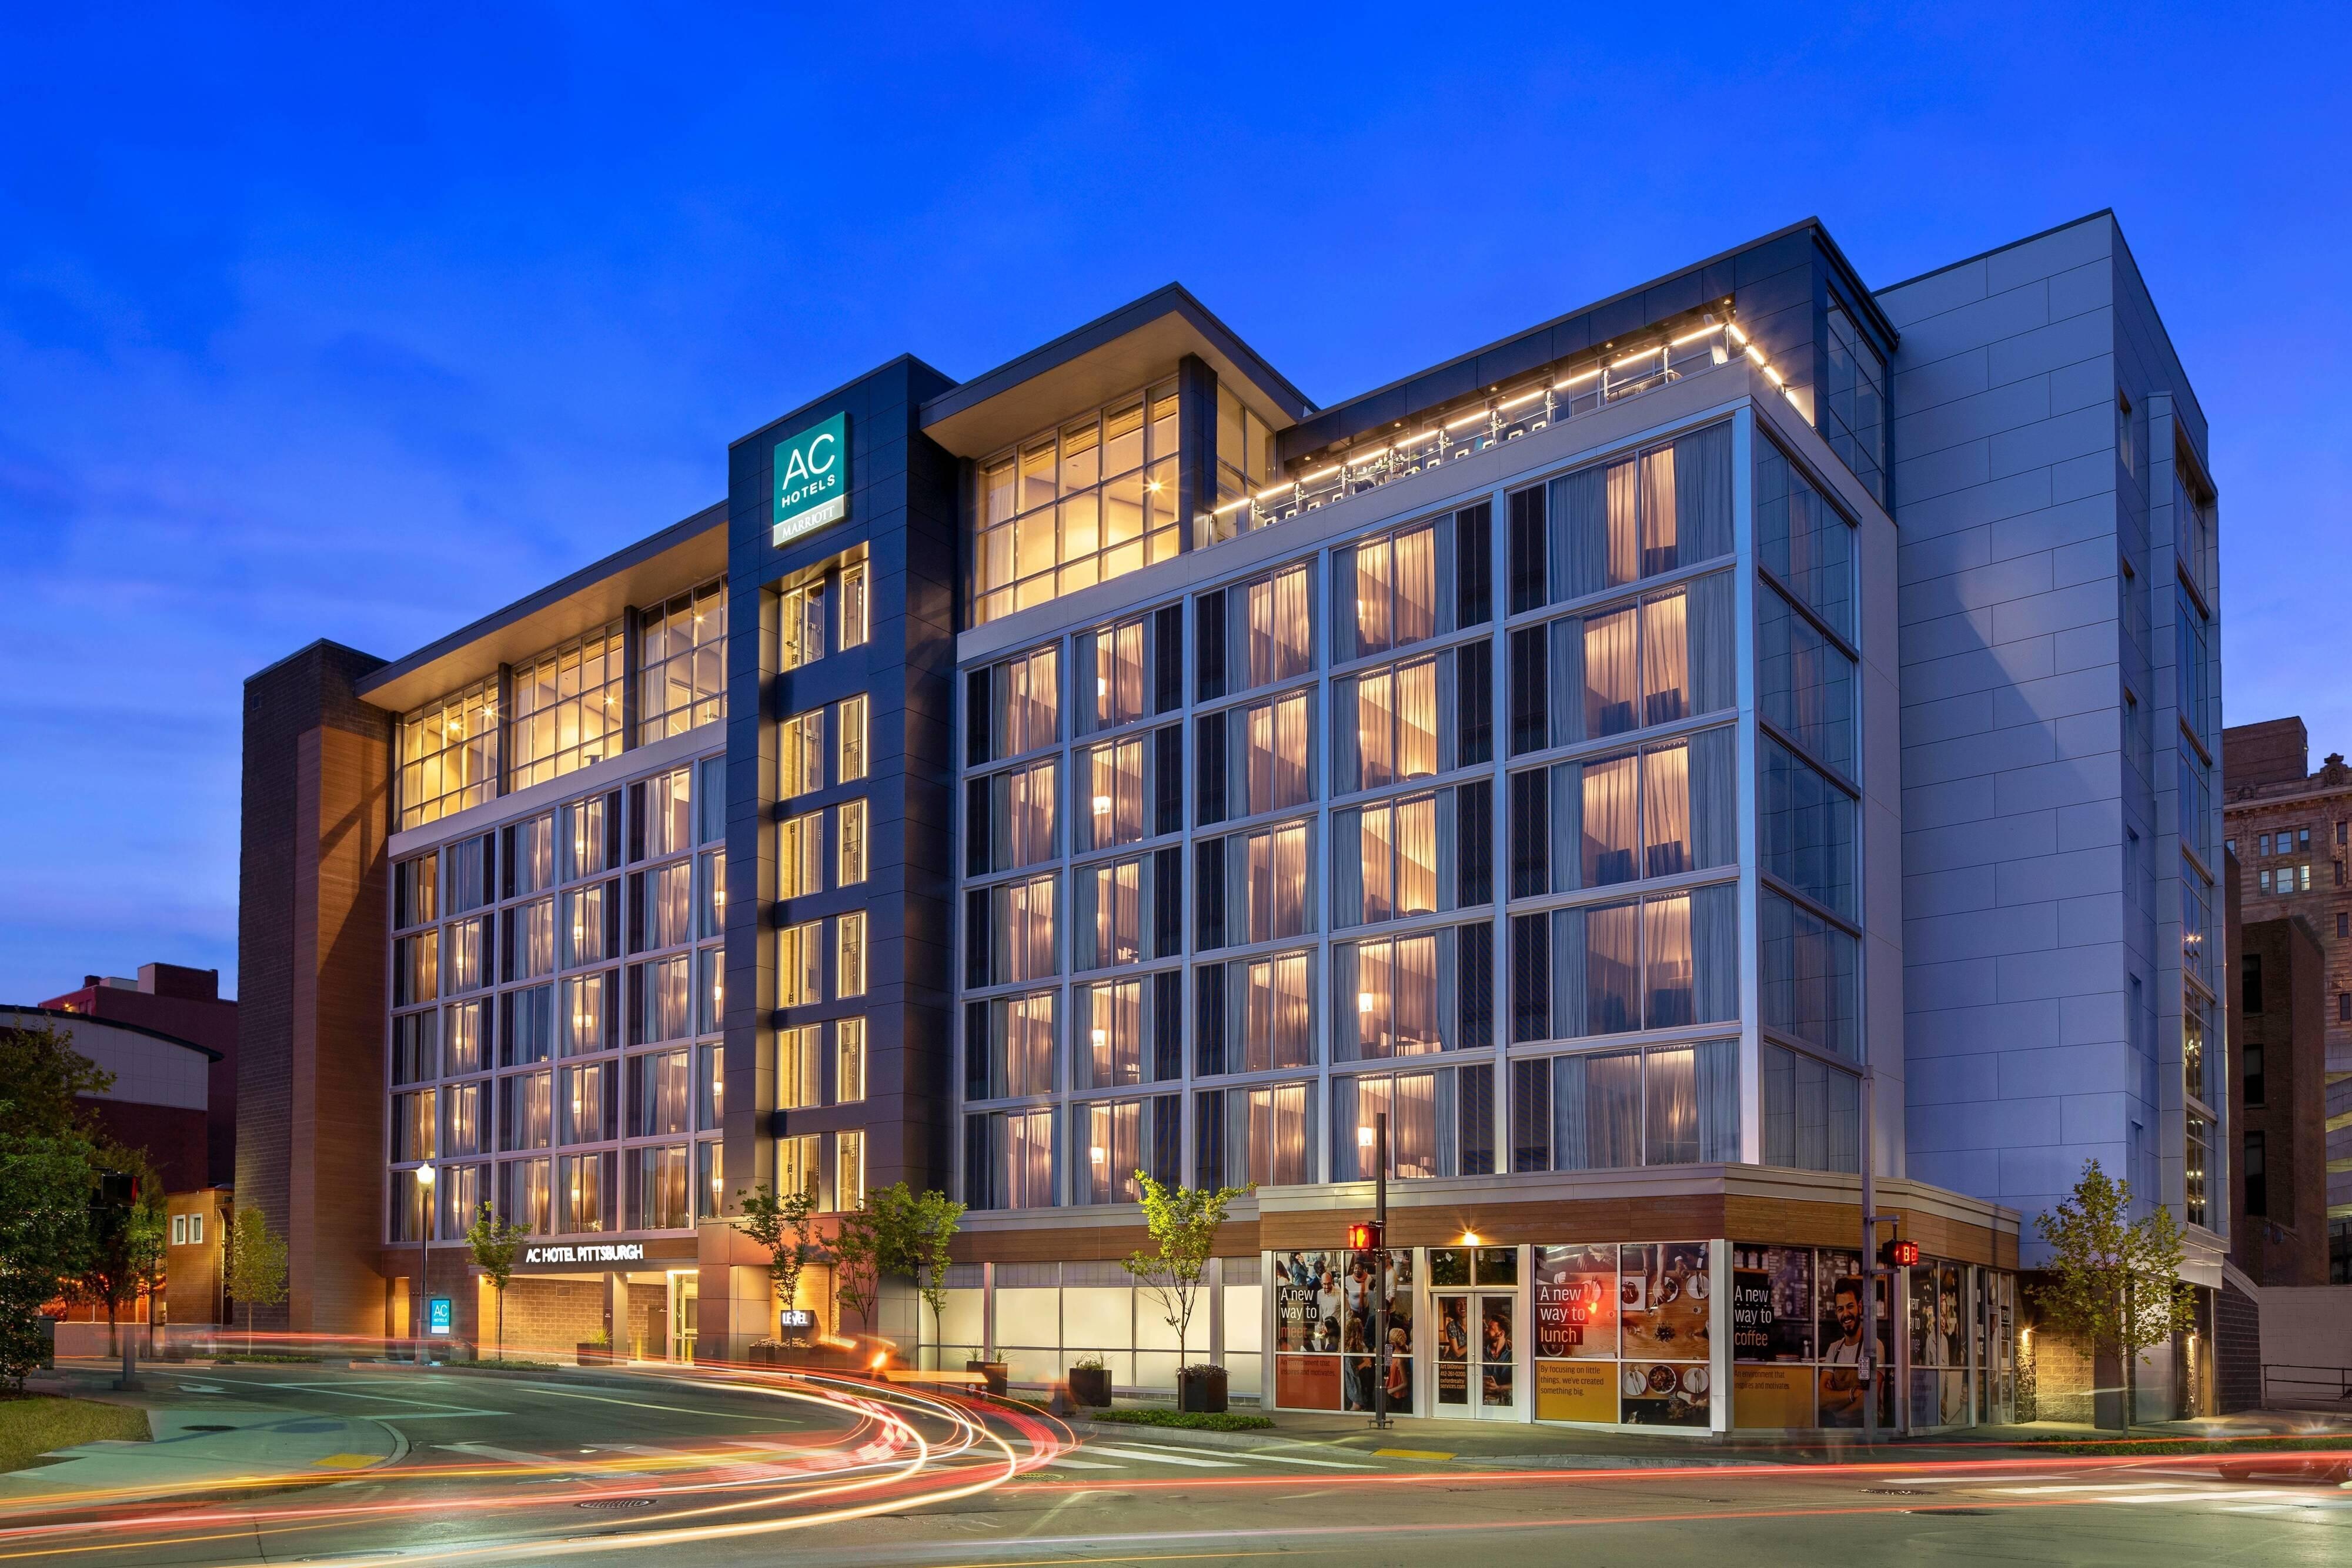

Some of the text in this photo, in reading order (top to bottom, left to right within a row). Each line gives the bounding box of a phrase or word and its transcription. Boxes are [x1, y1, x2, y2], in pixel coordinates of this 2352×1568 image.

[782, 433, 836, 490] AC
[781, 474, 836, 508] HOTELS
[782, 505, 835, 539] MARRIOTT
[526, 1244, 643, 1263] AC HOTEL PITTSBURGH
[1281, 1287, 1314, 1301] A new
[1540, 1286, 1581, 1301] A new
[1735, 1285, 1769, 1302] A new
[434, 1305, 447, 1317] AC
[1281, 1305, 1317, 1320] way to
[1540, 1306, 1585, 1323] way to
[1735, 1308, 1772, 1325] way to
[1281, 1326, 1308, 1338] meet
[1541, 1326, 1576, 1343] lunch
[1735, 1330, 1768, 1346] coffee
[1541, 1365, 1548, 1373] By
[1549, 1366, 1575, 1374] focusing
[1541, 1376, 1561, 1385] things,
[1541, 1388, 1585, 1396] something big.
